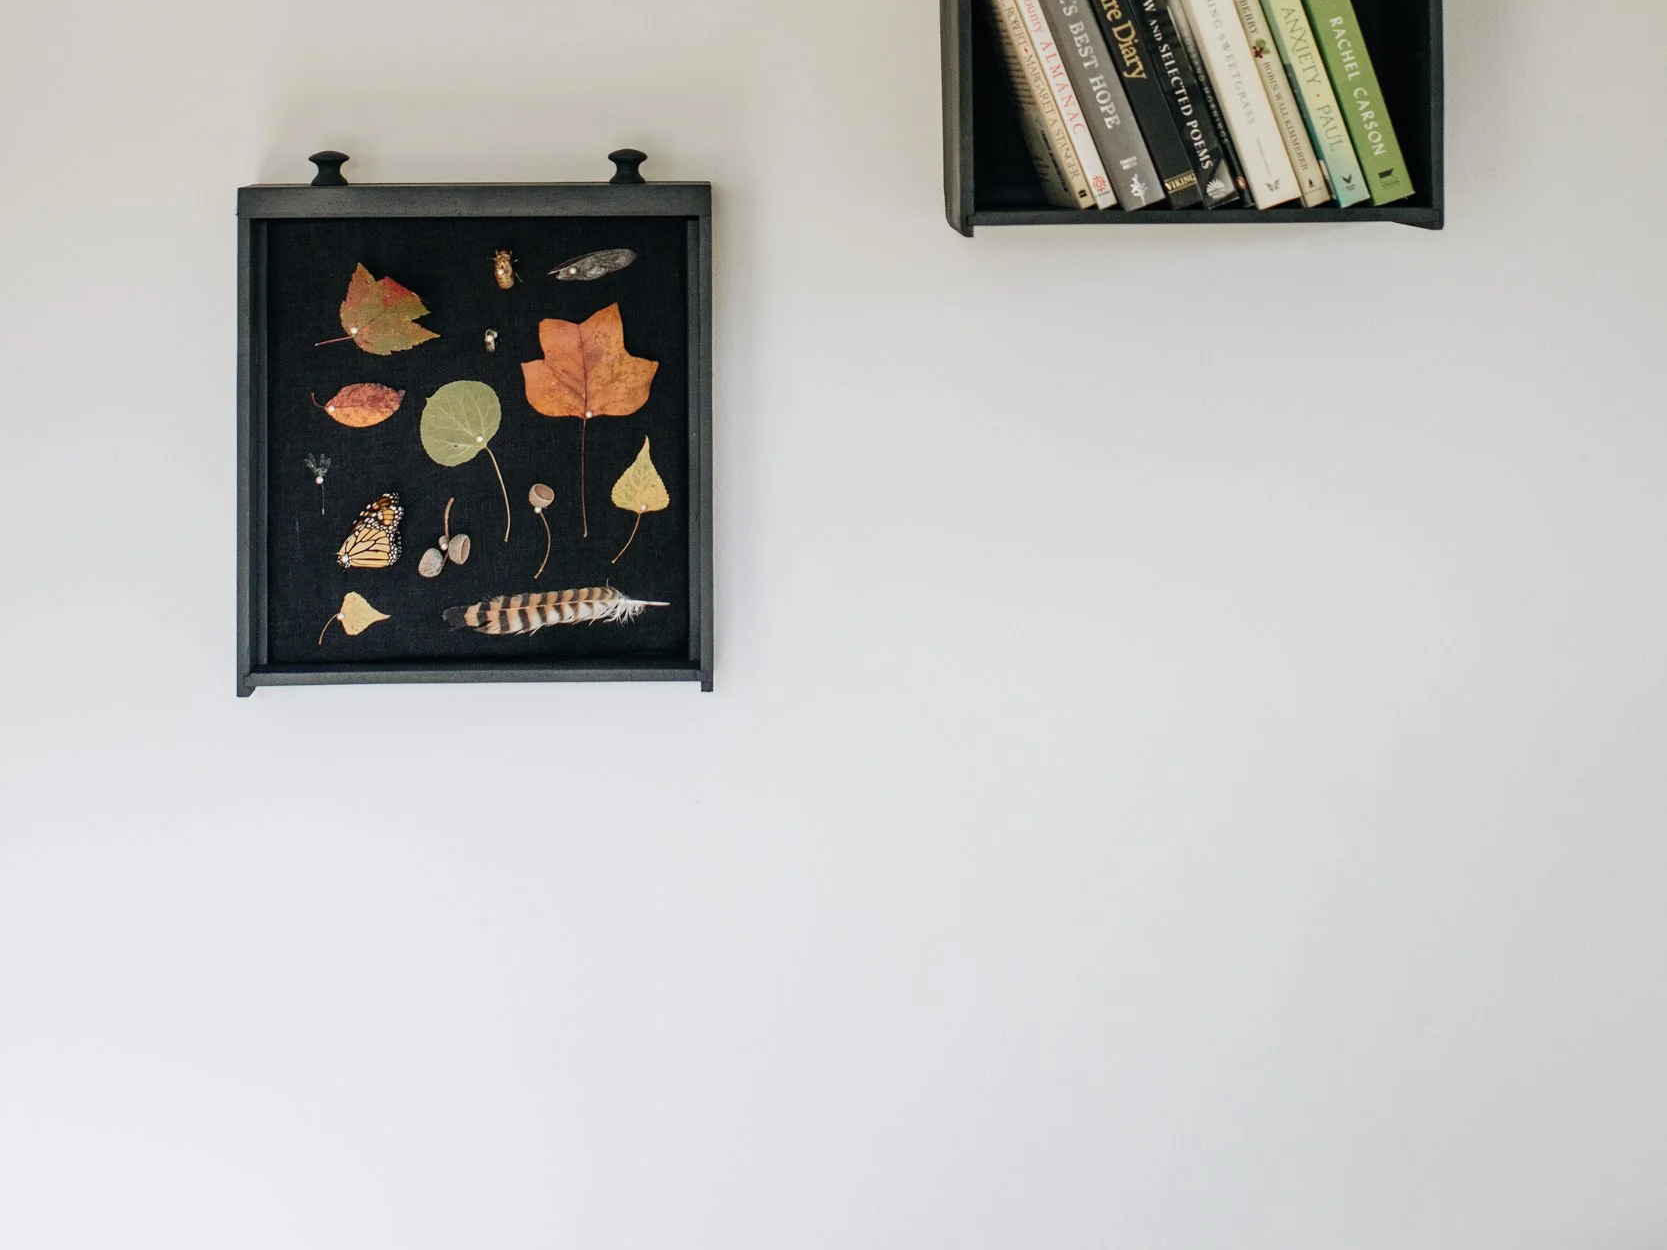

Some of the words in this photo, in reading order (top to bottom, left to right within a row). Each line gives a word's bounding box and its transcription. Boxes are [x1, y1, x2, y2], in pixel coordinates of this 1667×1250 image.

[1008, 7, 1027, 46] ROBERT
[1112, 20, 1147, 79] Diary
[1281, 6, 1321, 85] ANXIETY
[1024, 54, 1056, 115] MARGARET
[1048, 117, 1058, 126] A
[1055, 129, 1079, 181] STANGER
[1040, 41, 1085, 135] ALMANAC
[1069, 21, 1098, 68] BEST
[1089, 74, 1121, 129] HOPE
[1148, 19, 1163, 41] AND
[1158, 44, 1193, 116] SELECTED
[1186, 119, 1213, 170] POEMS
[1218, 33, 1255, 125] SWEETGRASS
[1263, 61, 1278, 91] ROBIN
[1275, 92, 1289, 119] WALL
[1284, 120, 1308, 170] KIMMERER
[1329, 16, 1361, 81] RACHEL
[1353, 87, 1387, 156] CARSON
[1316, 104, 1343, 152] PAUL
[1164, 173, 1196, 191] VIKING
